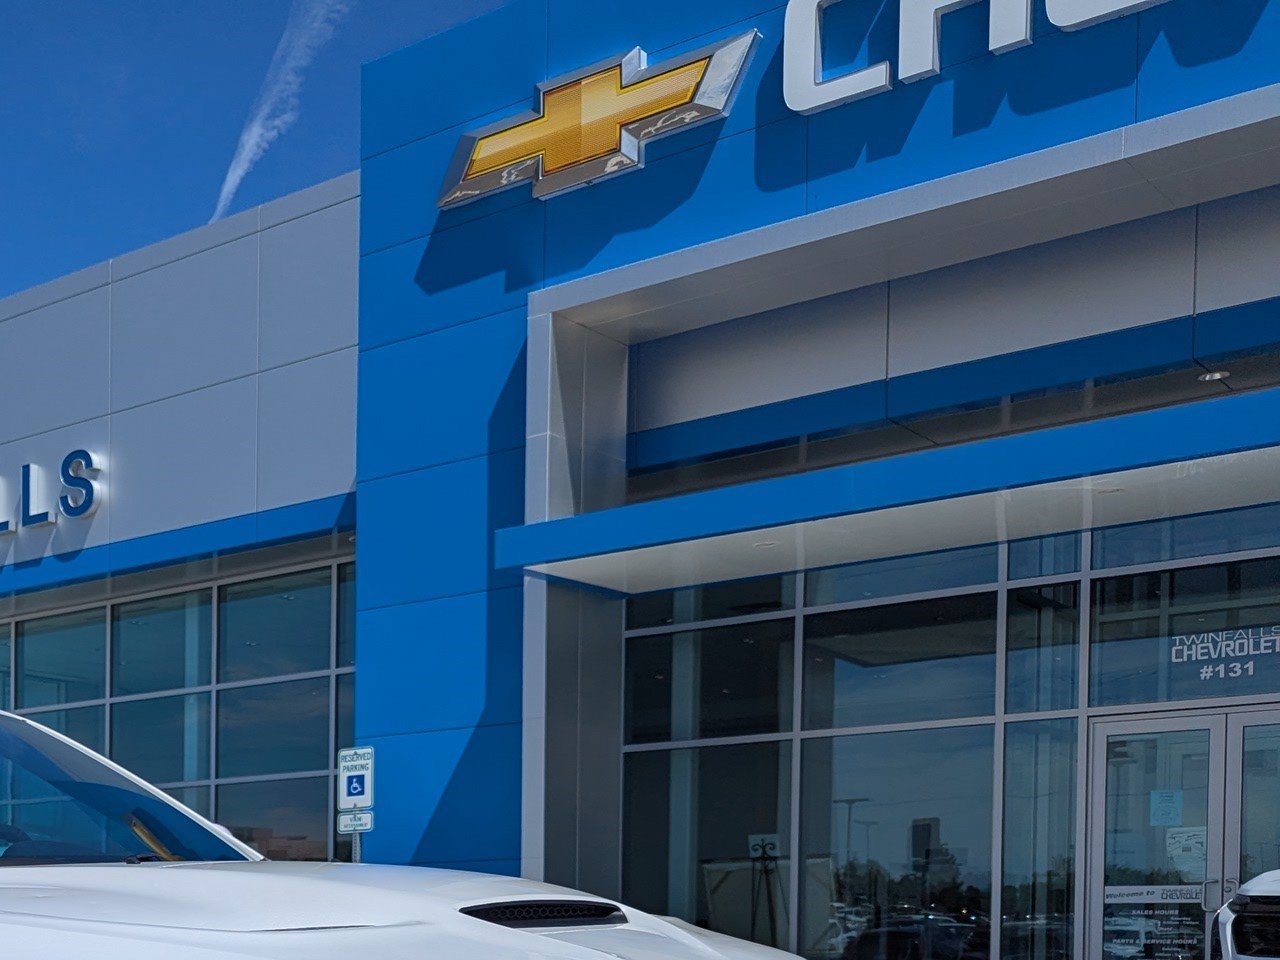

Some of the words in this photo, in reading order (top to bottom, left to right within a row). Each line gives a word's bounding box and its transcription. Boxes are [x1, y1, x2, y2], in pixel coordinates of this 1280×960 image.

[1200, 661, 1254, 680] #131
[340, 752, 371, 763] RESERVED
[342, 763, 369, 773] PARKING
